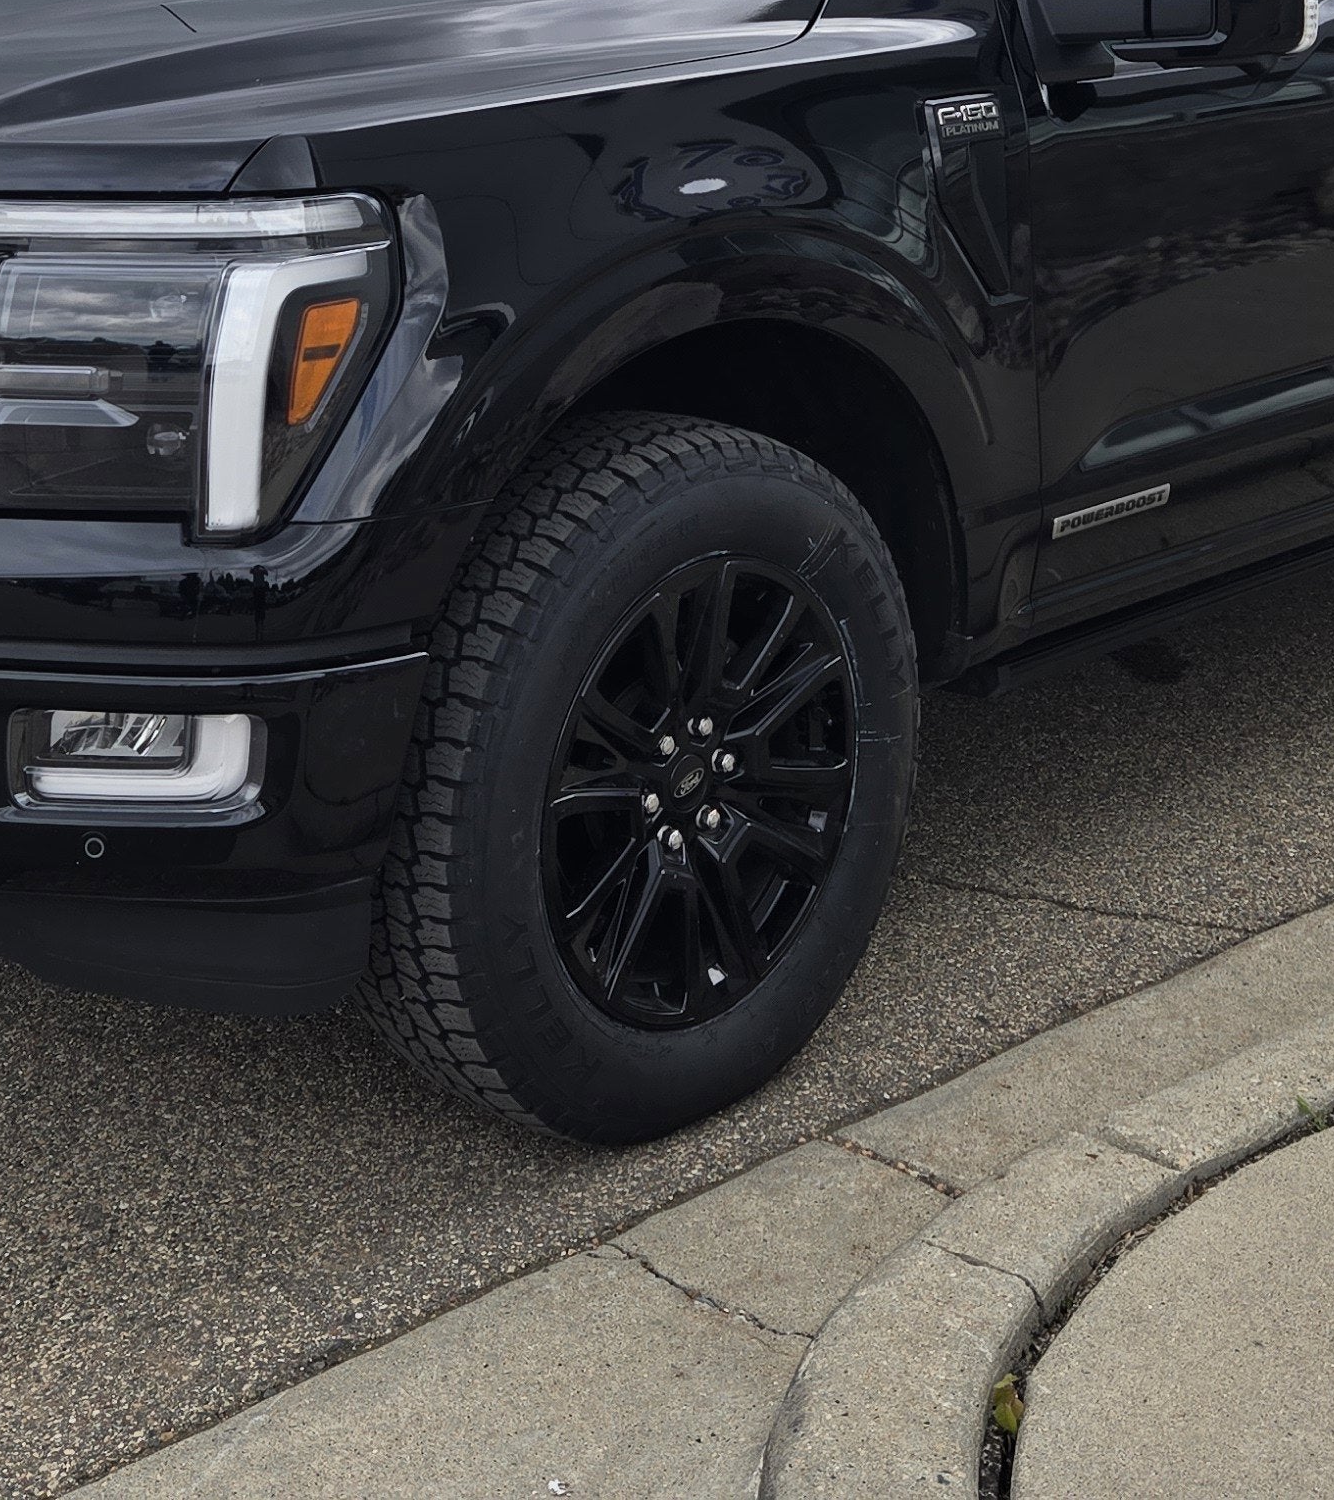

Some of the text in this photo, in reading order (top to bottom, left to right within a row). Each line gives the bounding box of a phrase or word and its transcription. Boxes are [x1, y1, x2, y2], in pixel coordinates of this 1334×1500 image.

[938, 101, 999, 125] F-150
[946, 120, 999, 137] PLATINUM
[1060, 490, 1166, 533] POWERBOOST
